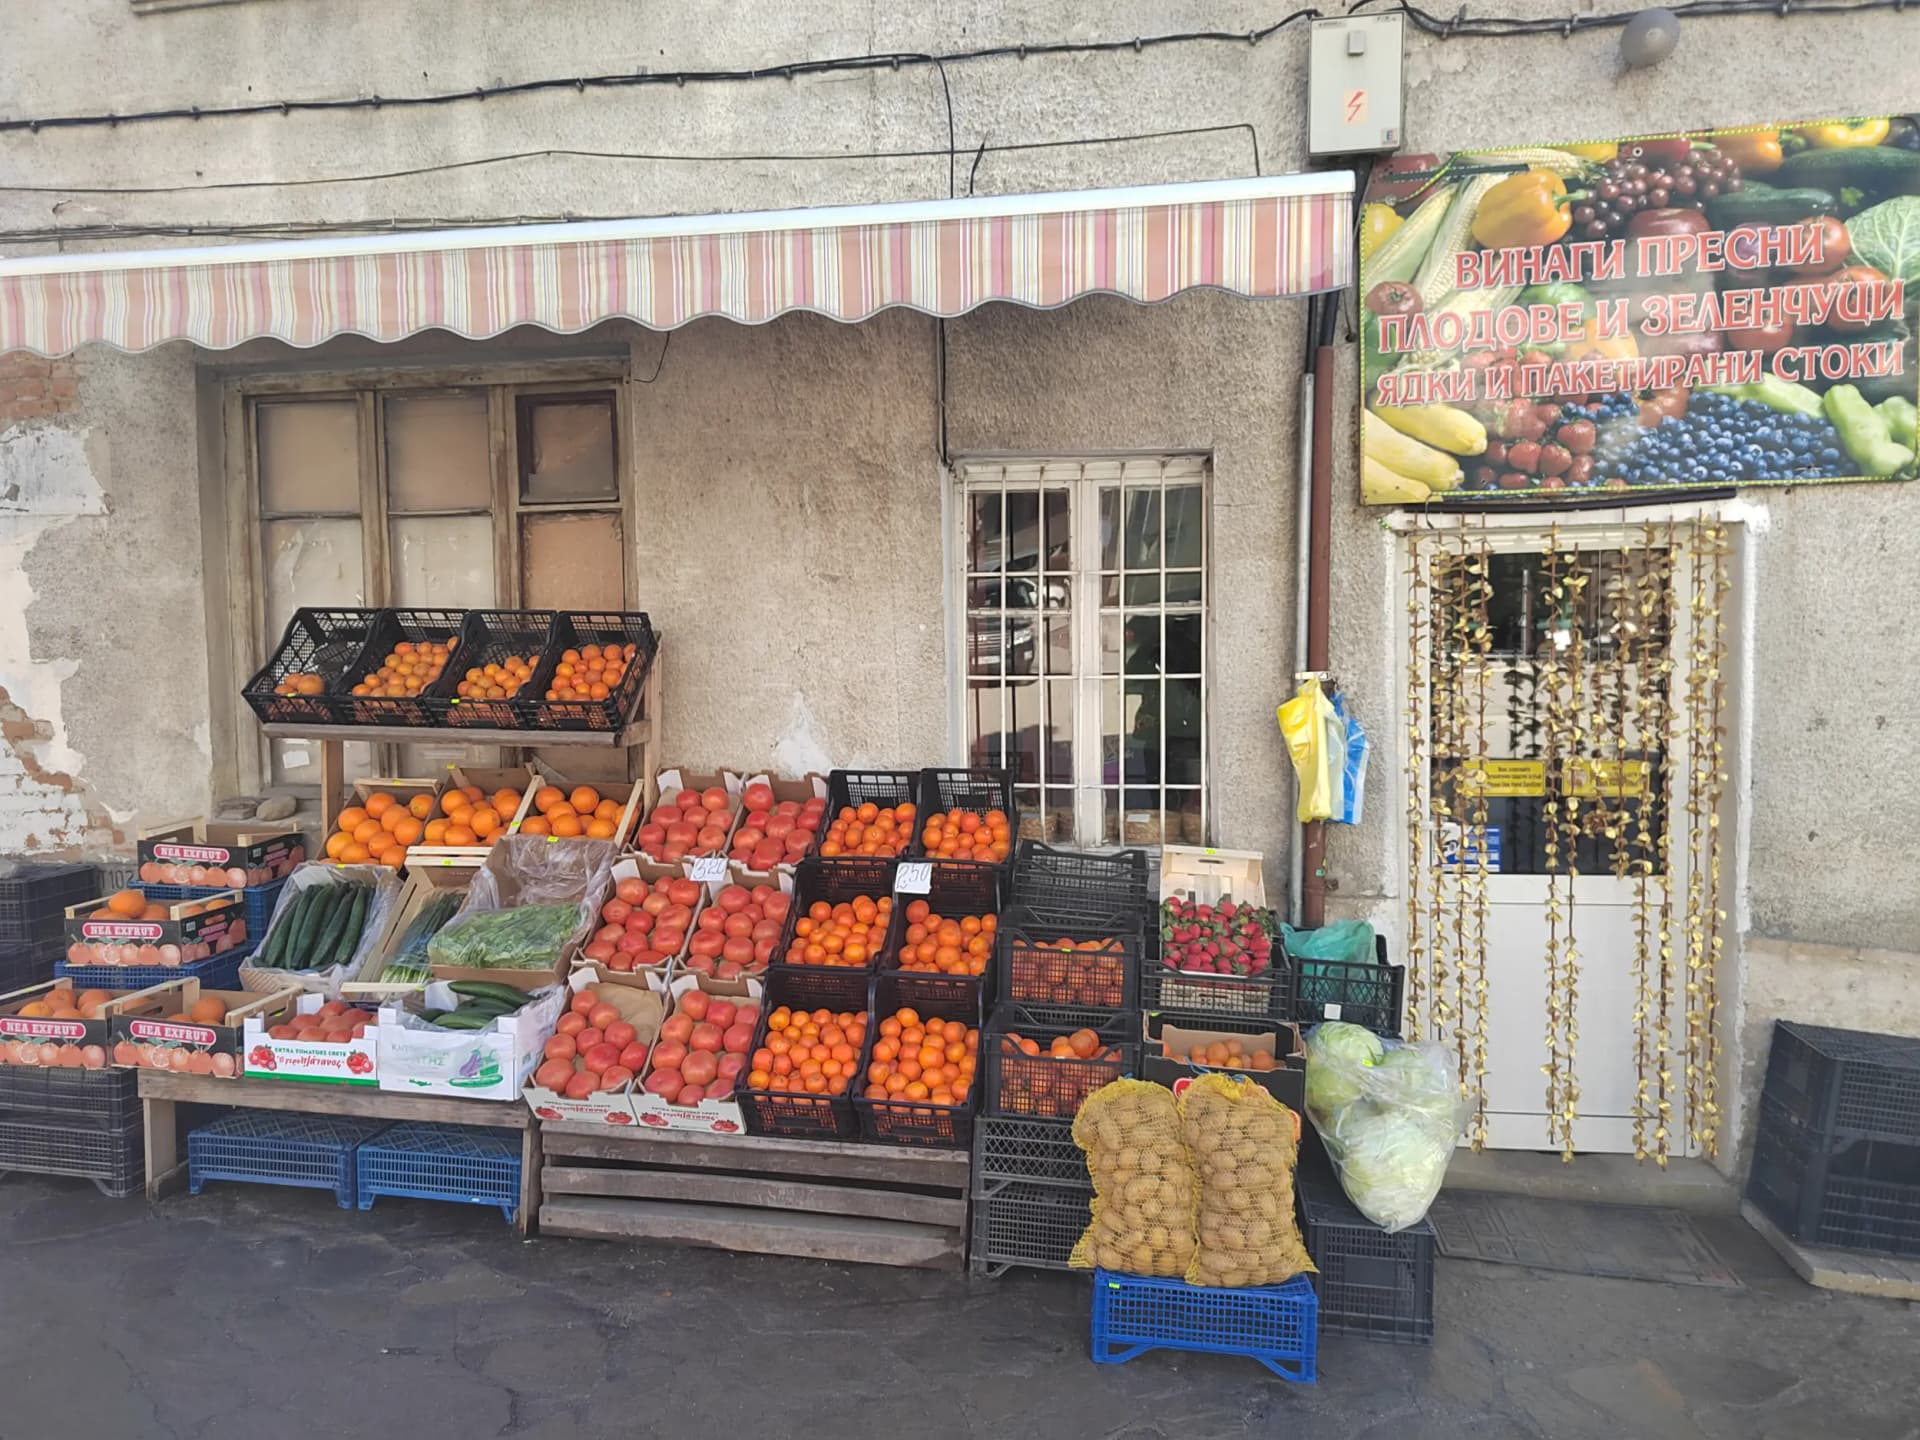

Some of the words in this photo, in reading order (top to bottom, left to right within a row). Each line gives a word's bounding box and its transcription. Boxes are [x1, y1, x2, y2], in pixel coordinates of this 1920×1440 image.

[1455, 237, 1626, 290] ВИНАГИ
[1637, 223, 1825, 278] ПРЕСНИ
[1378, 302, 1584, 353] ПЛОДОВЕ
[1596, 298, 1630, 340] И
[1641, 279, 1905, 337] ЗЕЛЕНЧУЦИ
[1376, 367, 1476, 408] ЯДКИ
[1484, 364, 1512, 401] И
[1521, 350, 1763, 399] ПАКЕТИРАНИ
[1772, 341, 1905, 383] СТОКИ
